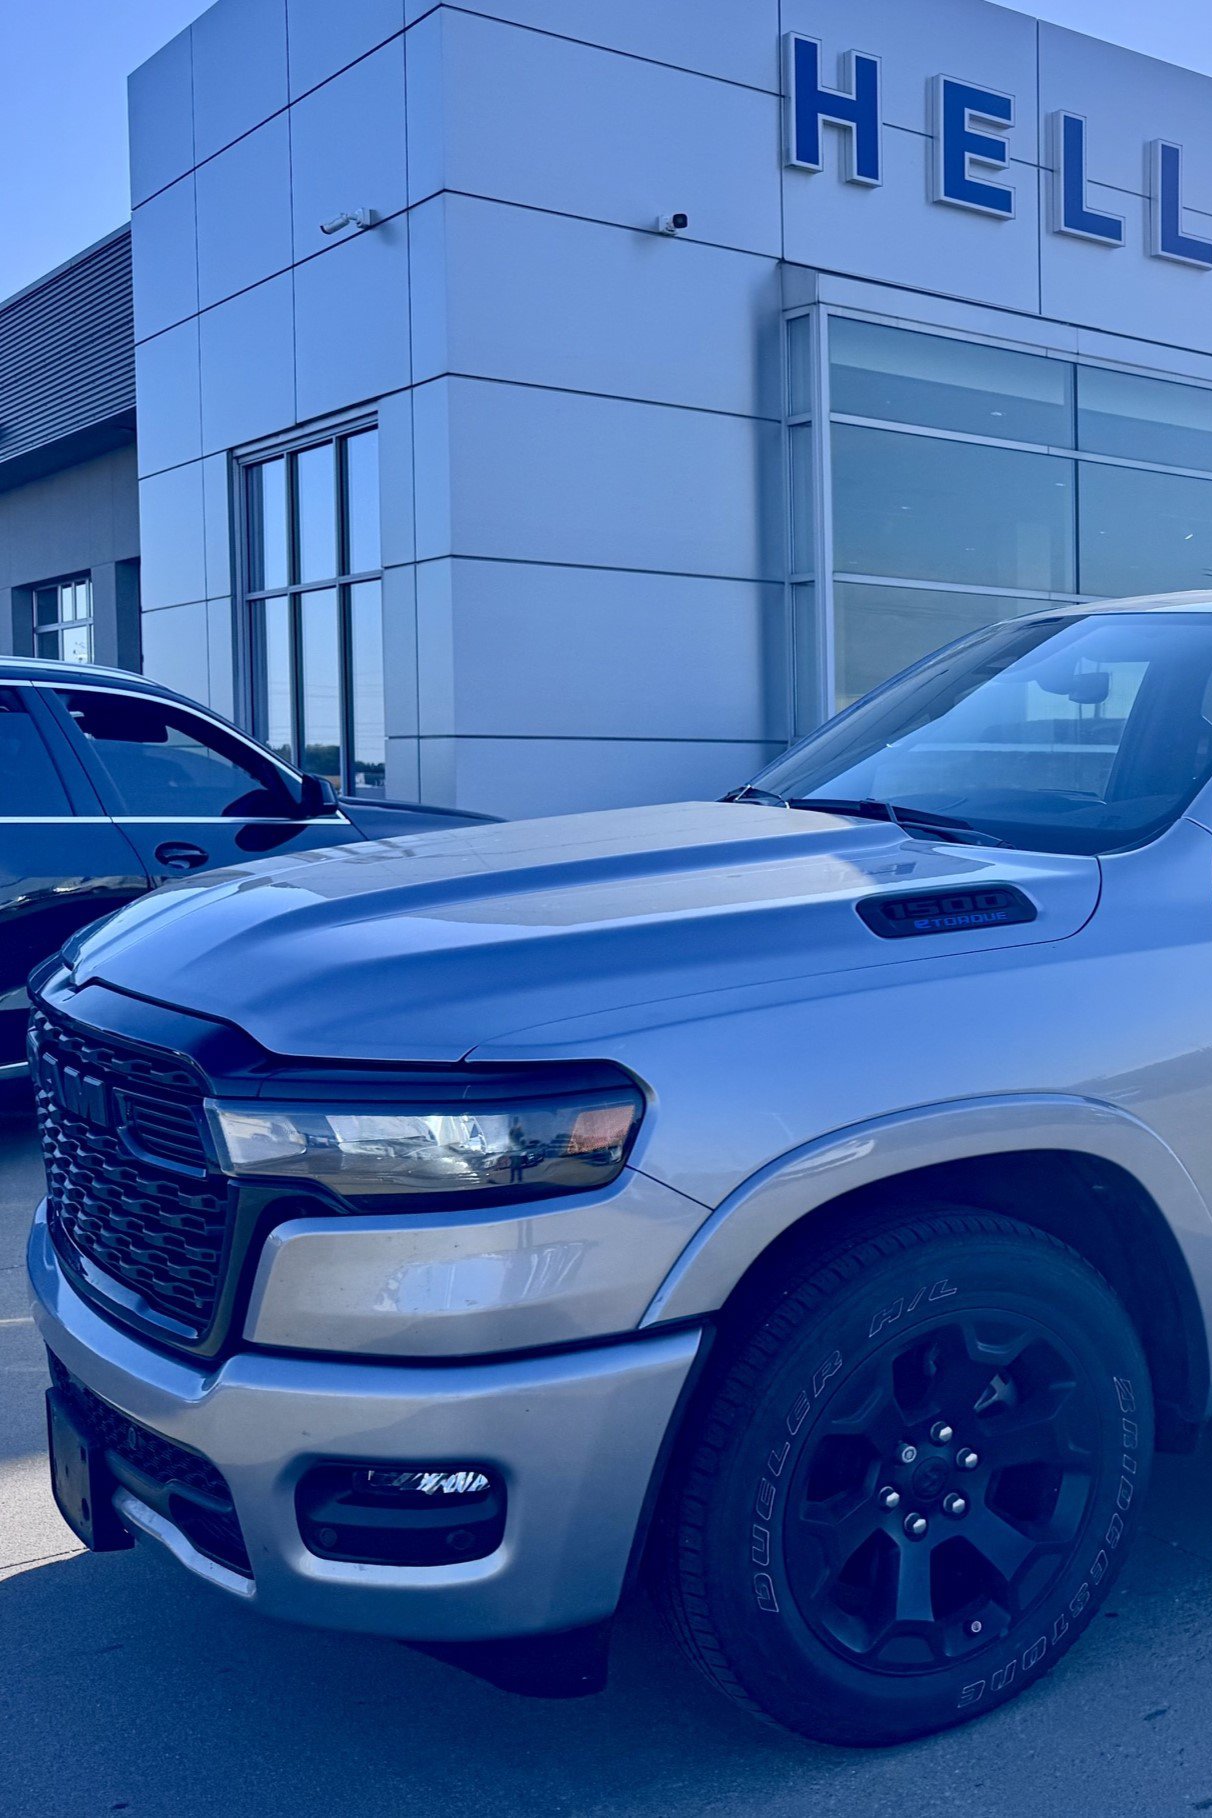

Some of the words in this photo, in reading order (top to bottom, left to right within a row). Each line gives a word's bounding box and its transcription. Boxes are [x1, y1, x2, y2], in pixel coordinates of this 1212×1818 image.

[885, 892, 1009, 919] 1500
[752, 1350, 843, 1613] DUELER
[957, 1376, 1137, 1709] BRIDGESTONE
